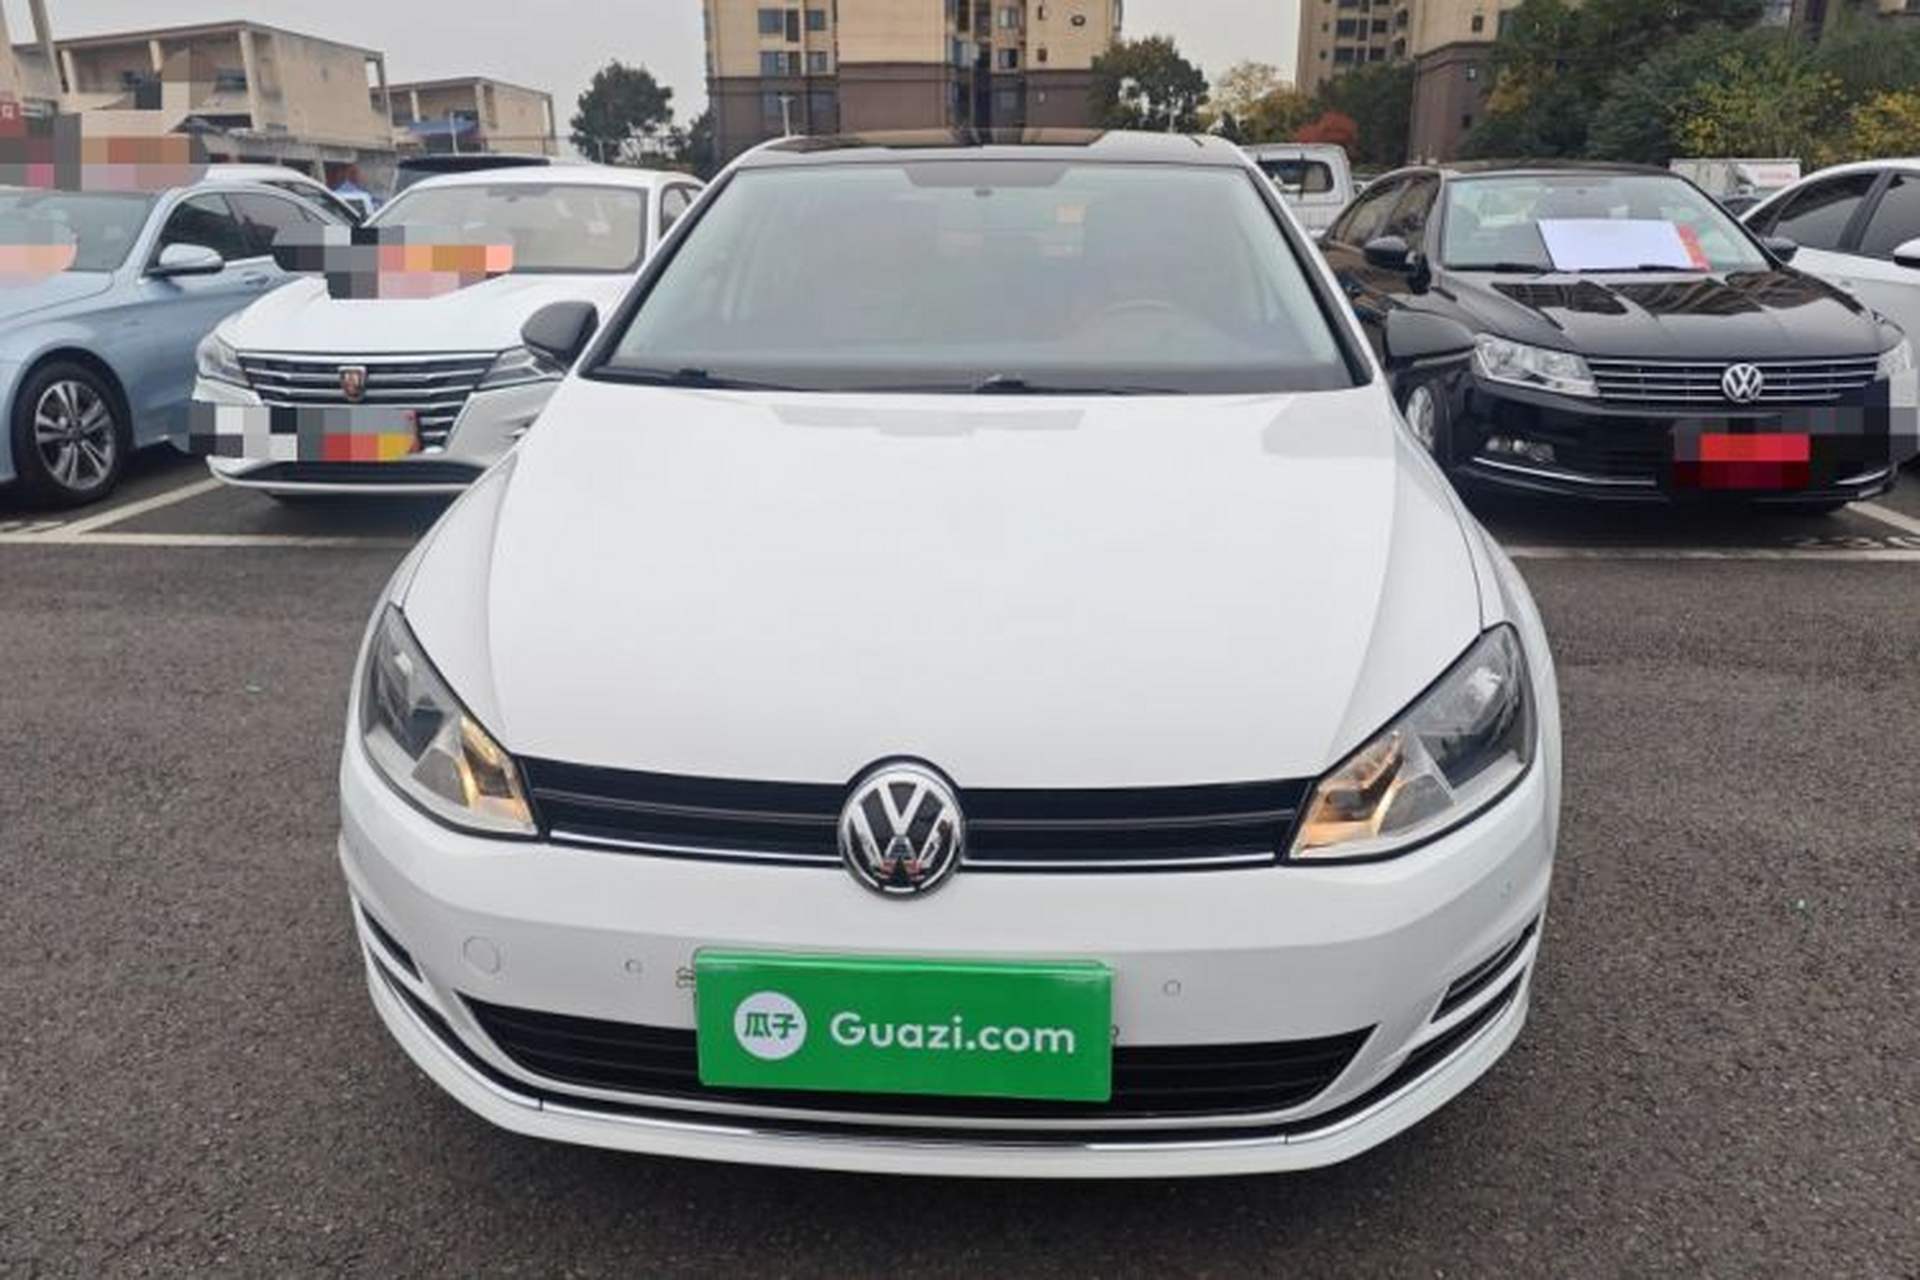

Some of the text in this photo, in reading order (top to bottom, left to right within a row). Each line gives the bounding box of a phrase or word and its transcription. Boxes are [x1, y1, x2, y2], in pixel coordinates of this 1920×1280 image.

[844, 768, 959, 892] VW
[744, 1011, 799, 1040] 瓜子
[829, 1011, 1075, 1054] Guazi.com
